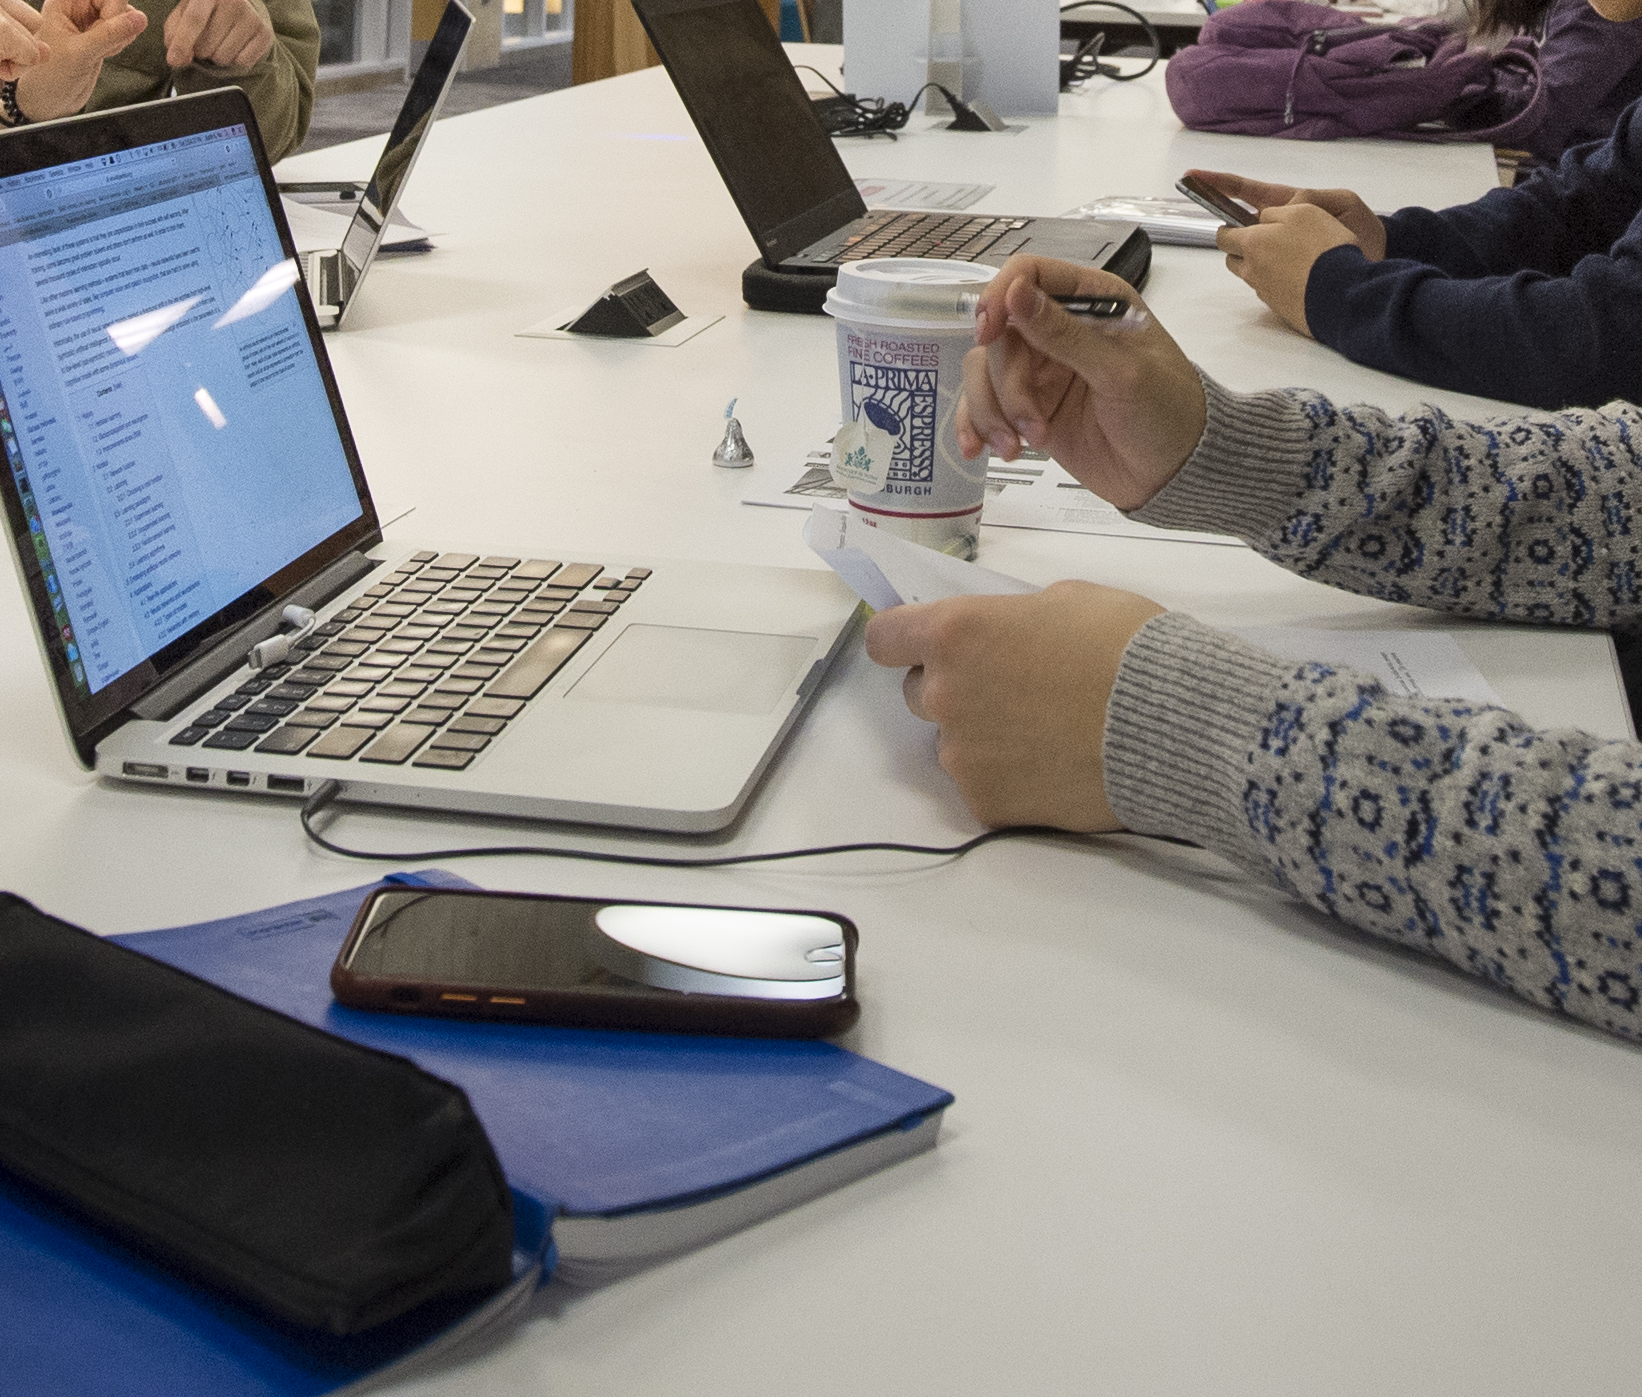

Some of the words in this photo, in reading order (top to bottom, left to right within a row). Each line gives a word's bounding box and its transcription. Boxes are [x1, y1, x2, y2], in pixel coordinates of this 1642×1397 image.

[847, 334, 877, 349] FRESH
[880, 340, 940, 354] ROASTED
[847, 345, 871, 362] FINE
[873, 351, 939, 367] COFFEES
[912, 395, 934, 480] ESPRESSO
